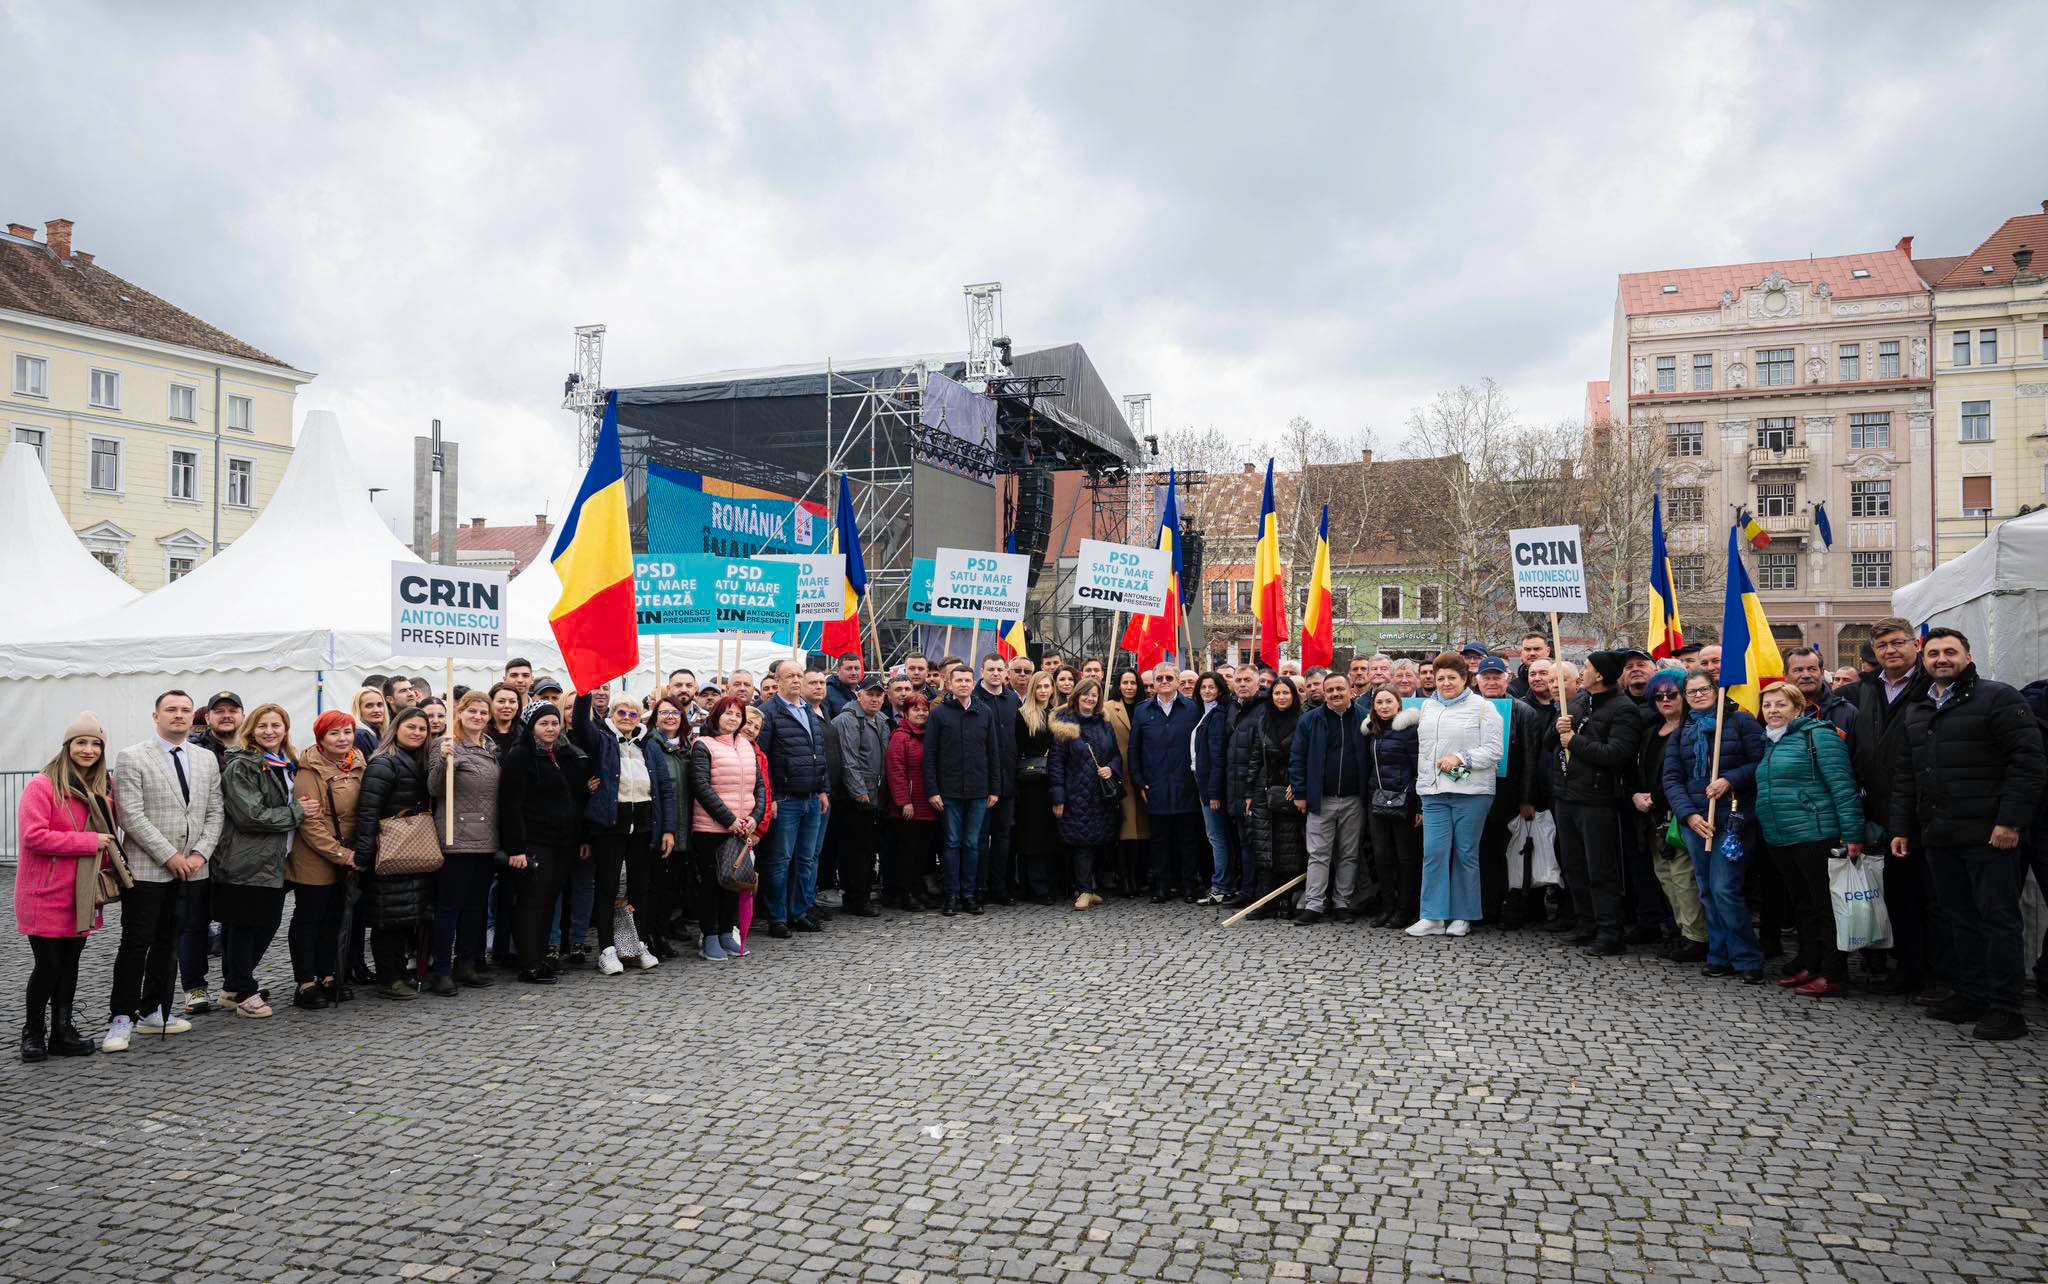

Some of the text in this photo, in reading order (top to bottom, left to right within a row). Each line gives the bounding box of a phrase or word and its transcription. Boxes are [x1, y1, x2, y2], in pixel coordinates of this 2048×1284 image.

[711, 501, 787, 543] ROMÂNIA,
[1109, 551, 1140, 566] PSD
[1515, 540, 1578, 566] CRIN
[636, 563, 676, 578] PSD
[967, 558, 998, 571] PSD
[1092, 562, 1155, 579] SATU MARE
[726, 564, 763, 580] PSD
[950, 571, 1013, 584] SATU MARE
[1519, 569, 1579, 582] ANTONESCU
[634, 580, 697, 591] TU MARE
[715, 579, 780, 594] ATU MARE
[799, 577, 829, 587] MARE
[1093, 575, 1149, 592] VOTEAZĂ
[400, 576, 499, 610] CRIN
[797, 587, 826, 600] EAZĂ
[952, 584, 1008, 597] VOTEAZĂ
[1079, 586, 1161, 602] CRIN ANTONESCU
[1520, 586, 1581, 600] PREȘEDINTE
[635, 591, 693, 607] OTEAZĂ
[937, 597, 982, 610] CRIN
[400, 609, 499, 629] ANTONESCU
[637, 611, 661, 624] IN
[663, 617, 711, 625] PREȘEDINTE
[717, 608, 791, 621] IN ANTONESCU
[746, 617, 790, 625] PREȘEDINTE
[401, 628, 499, 648] PREȘEDINTE
